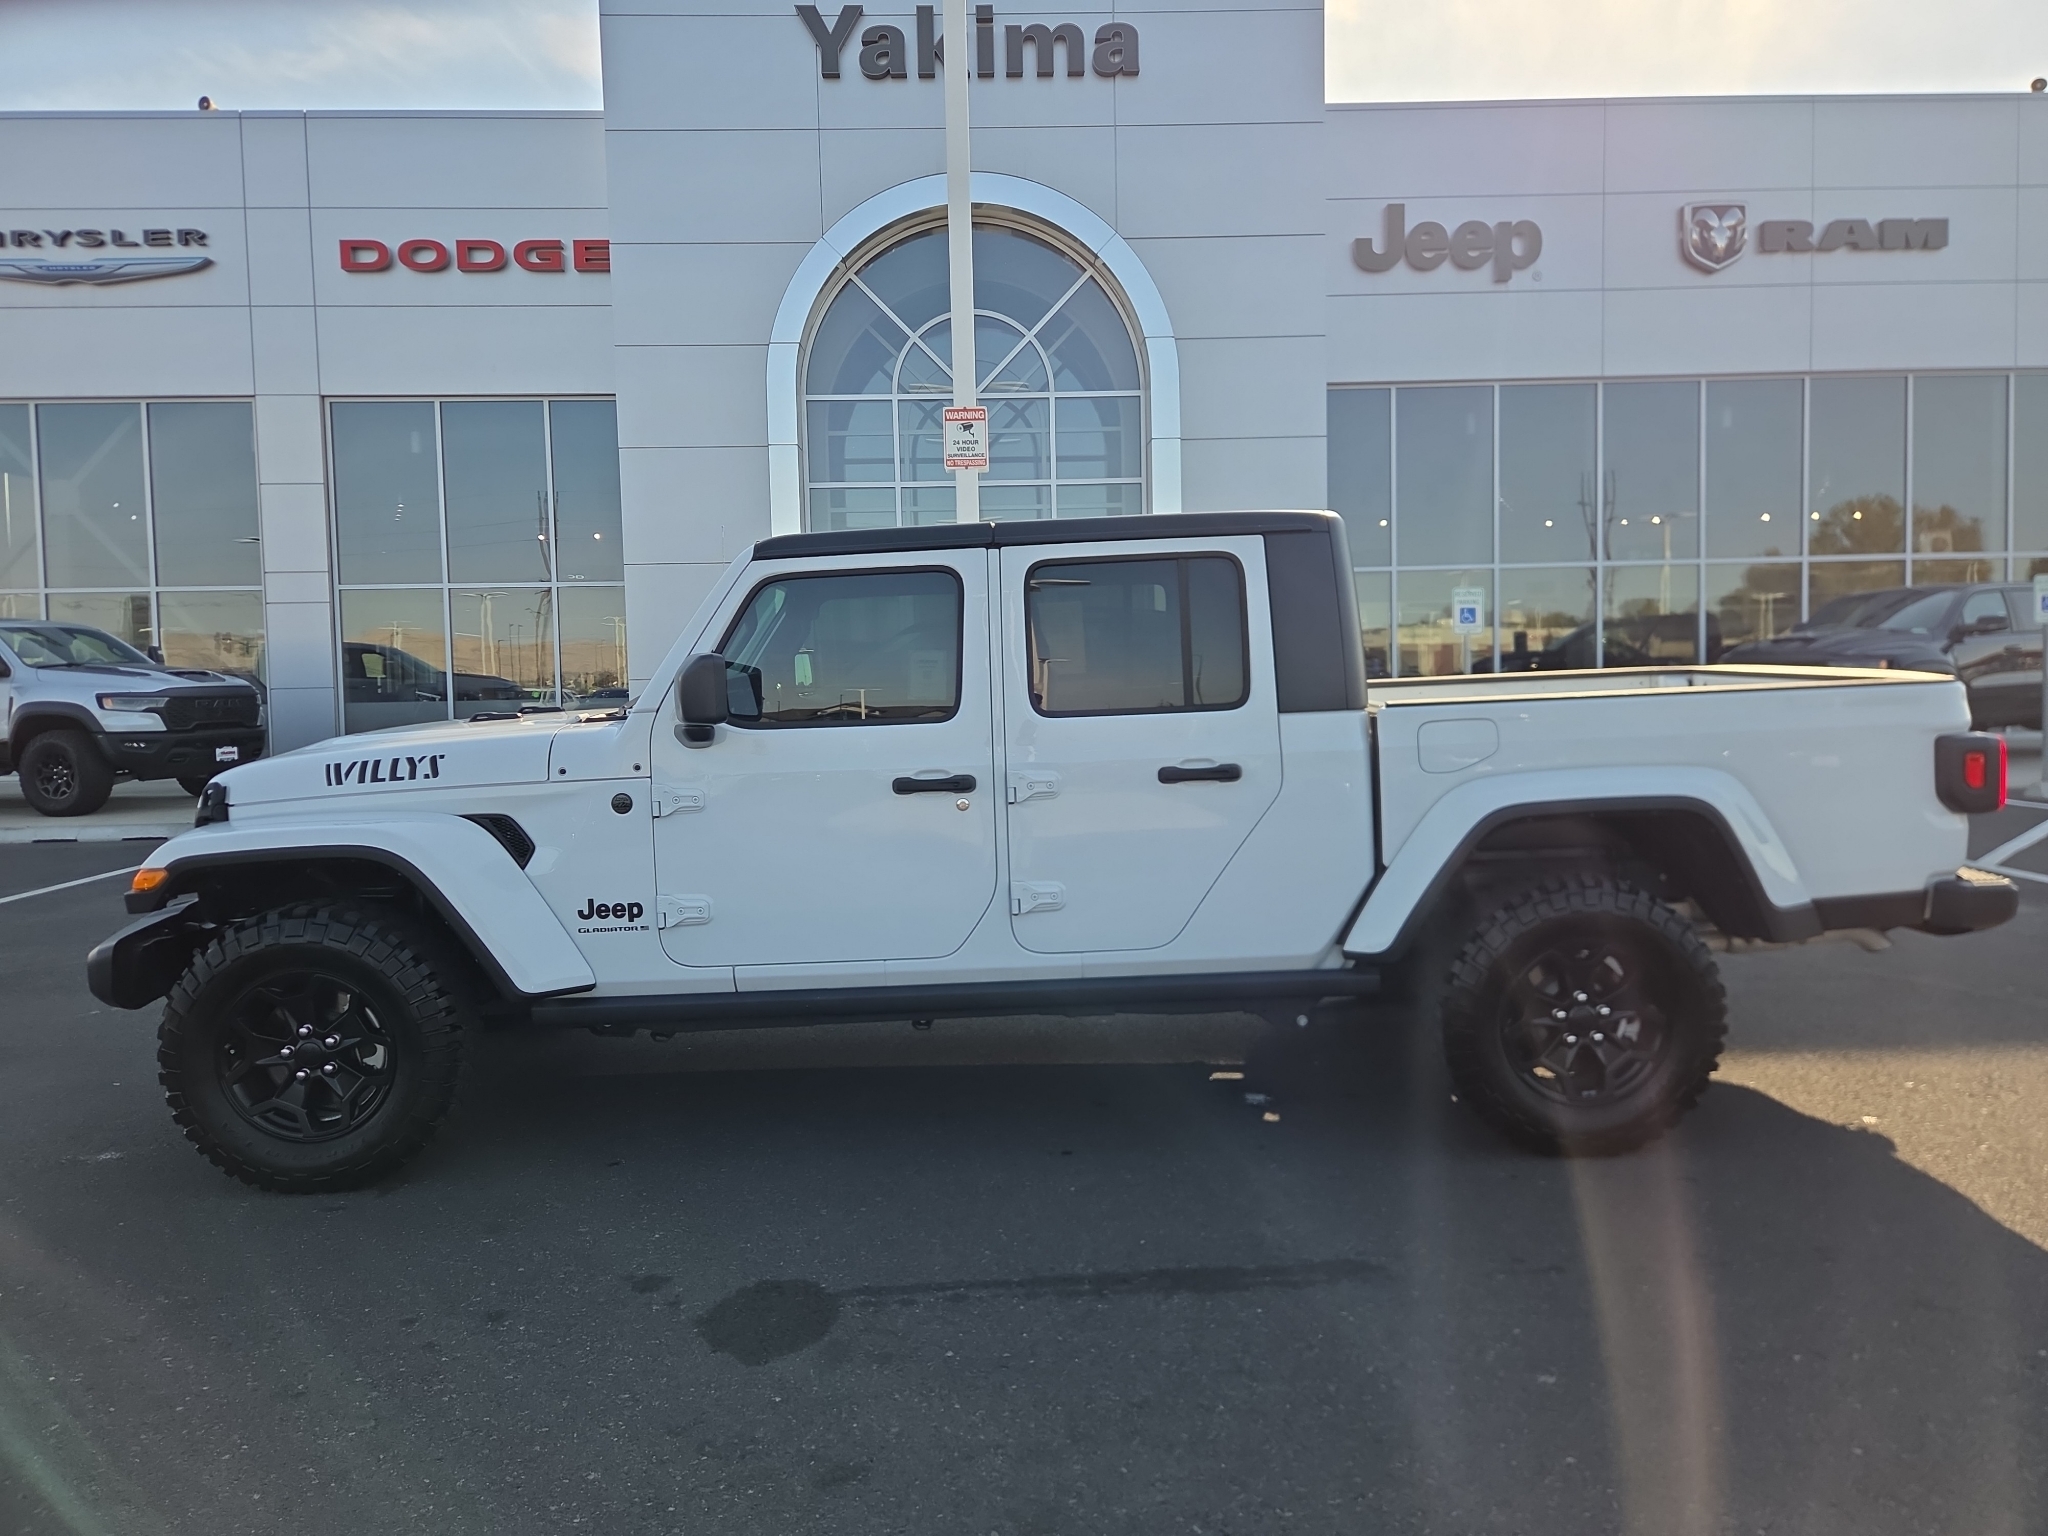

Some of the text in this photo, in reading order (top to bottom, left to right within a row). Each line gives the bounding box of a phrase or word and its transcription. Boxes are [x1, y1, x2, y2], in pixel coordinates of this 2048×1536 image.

[794, 4, 1140, 79] Yakima
[0, 229, 208, 247] RYSLER
[1353, 203, 1542, 283] Jeep
[1757, 217, 1949, 253] RAM
[339, 239, 611, 273] DODGE
[946, 411, 984, 420] WARNING
[325, 754, 446, 787] WILLYS
[577, 898, 644, 923] Jeep
[578, 925, 639, 934] GLADIATOR
